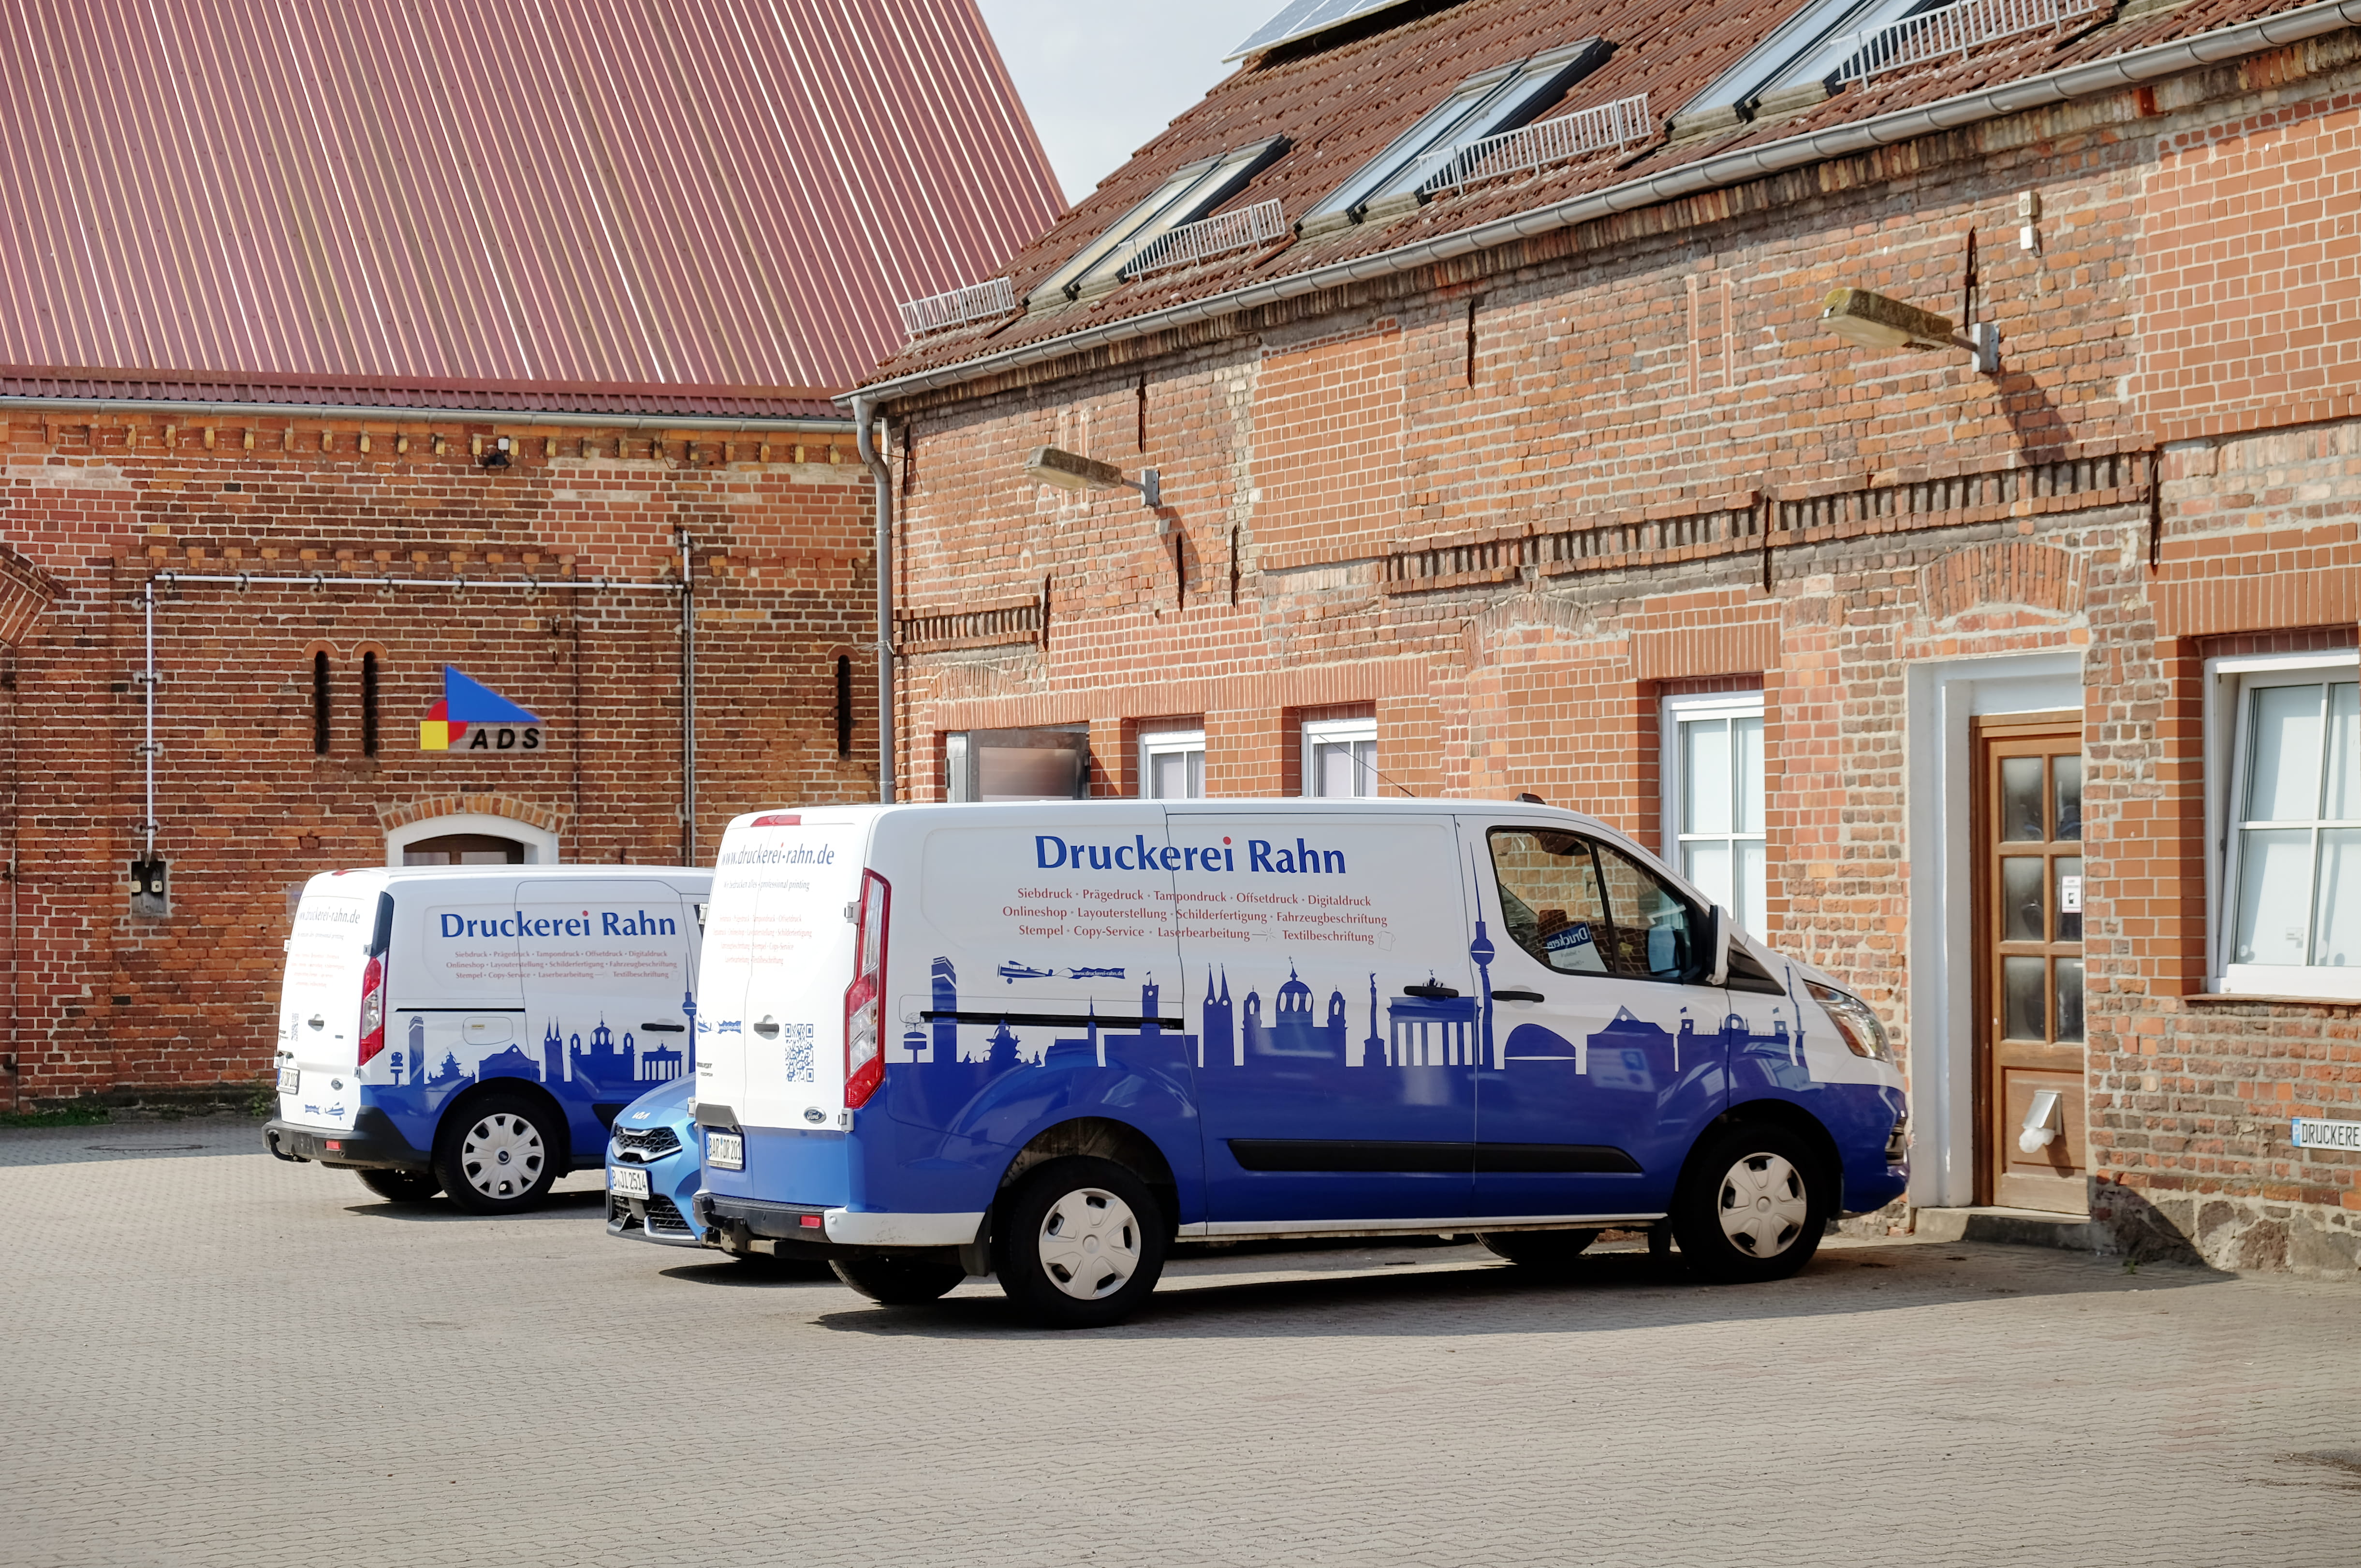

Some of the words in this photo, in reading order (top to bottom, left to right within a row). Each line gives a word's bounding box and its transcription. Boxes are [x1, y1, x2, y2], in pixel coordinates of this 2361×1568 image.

[469, 728, 540, 749] ADS
[721, 842, 835, 866] www.druckerei-rahn.de
[1035, 835, 1234, 872] Druckerei
[1248, 838, 1346, 874] Rahn
[760, 879, 788, 891] professional
[789, 879, 810, 892] printing
[1017, 888, 1072, 899] Siebdruck
[1083, 889, 1144, 903] Prägedruck
[1154, 891, 1227, 904] Tampondruck
[1236, 893, 1298, 904] Offsetdruck
[1308, 894, 1371, 908] Digitaldruck
[440, 910, 590, 938] Druckerei
[601, 910, 676, 937] Rahn
[1002, 906, 1067, 920] Onlineshop
[1077, 907, 1167, 922] Layouterstellung
[1176, 909, 1267, 924] Schilderfertigung
[1276, 911, 1388, 927] Fahrzeugbeschriftung
[1019, 925, 1063, 938] Stempel
[1073, 925, 1144, 939] Copy-Service
[1158, 927, 1250, 942] Laserbearbeitung
[1282, 930, 1374, 945] Textilbeschriftung
[446, 961, 485, 969] Onlineshop
[490, 961, 544, 969] Layouterstellung
[549, 961, 604, 969] Schilderfertigung
[609, 960, 677, 969] Fahrzeugbeschriftung
[493, 951, 530, 960] Prägedruck
[536, 951, 580, 959] Tampondruck
[629, 950, 668, 959] Digitaldruck
[455, 971, 483, 980] Stempel
[488, 971, 530, 980] Copy-Service
[538, 971, 594, 980] Laserbearbeitung
[613, 971, 669, 980] Textilbeschriftung
[2302, 1123, 2361, 1147] DRUCKERE
[709, 1137, 719, 1158] BAR
[731, 1140, 741, 1161] 201
[612, 1169, 617, 1187] B
[629, 1172, 646, 1192] 2514
